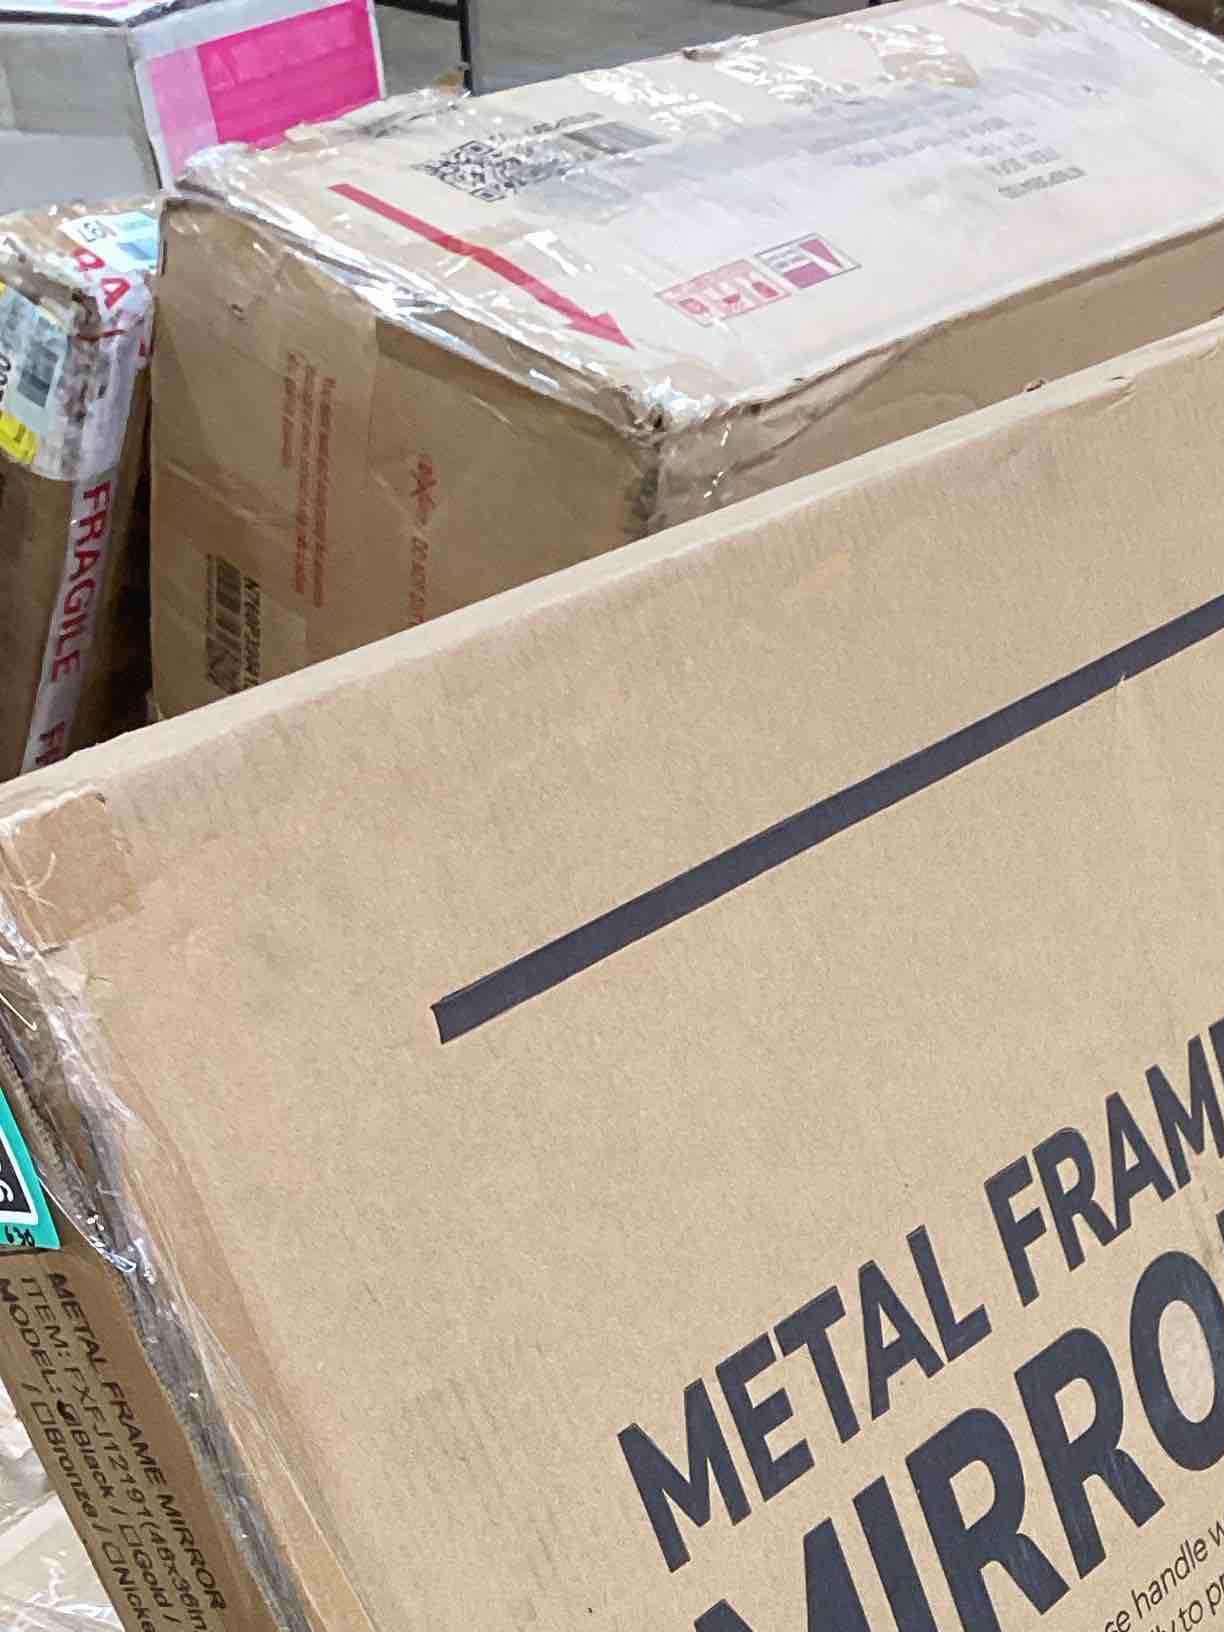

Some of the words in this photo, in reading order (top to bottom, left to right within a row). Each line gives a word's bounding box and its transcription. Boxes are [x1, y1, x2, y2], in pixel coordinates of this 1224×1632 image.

[51, 480, 112, 684] FRAGILE
[0, 1278, 65, 1396] MODEL:
[21, 1277, 73, 1360] ITEM:
[48, 1272, 108, 1370] METAL
[102, 1379, 170, 1488] FRAME
[156, 1491, 227, 1611] MIRROR
[617, 1225, 992, 1574] METAL
[1130, 1536, 1210, 1621] handle
[1178, 1599, 1204, 1632] to
